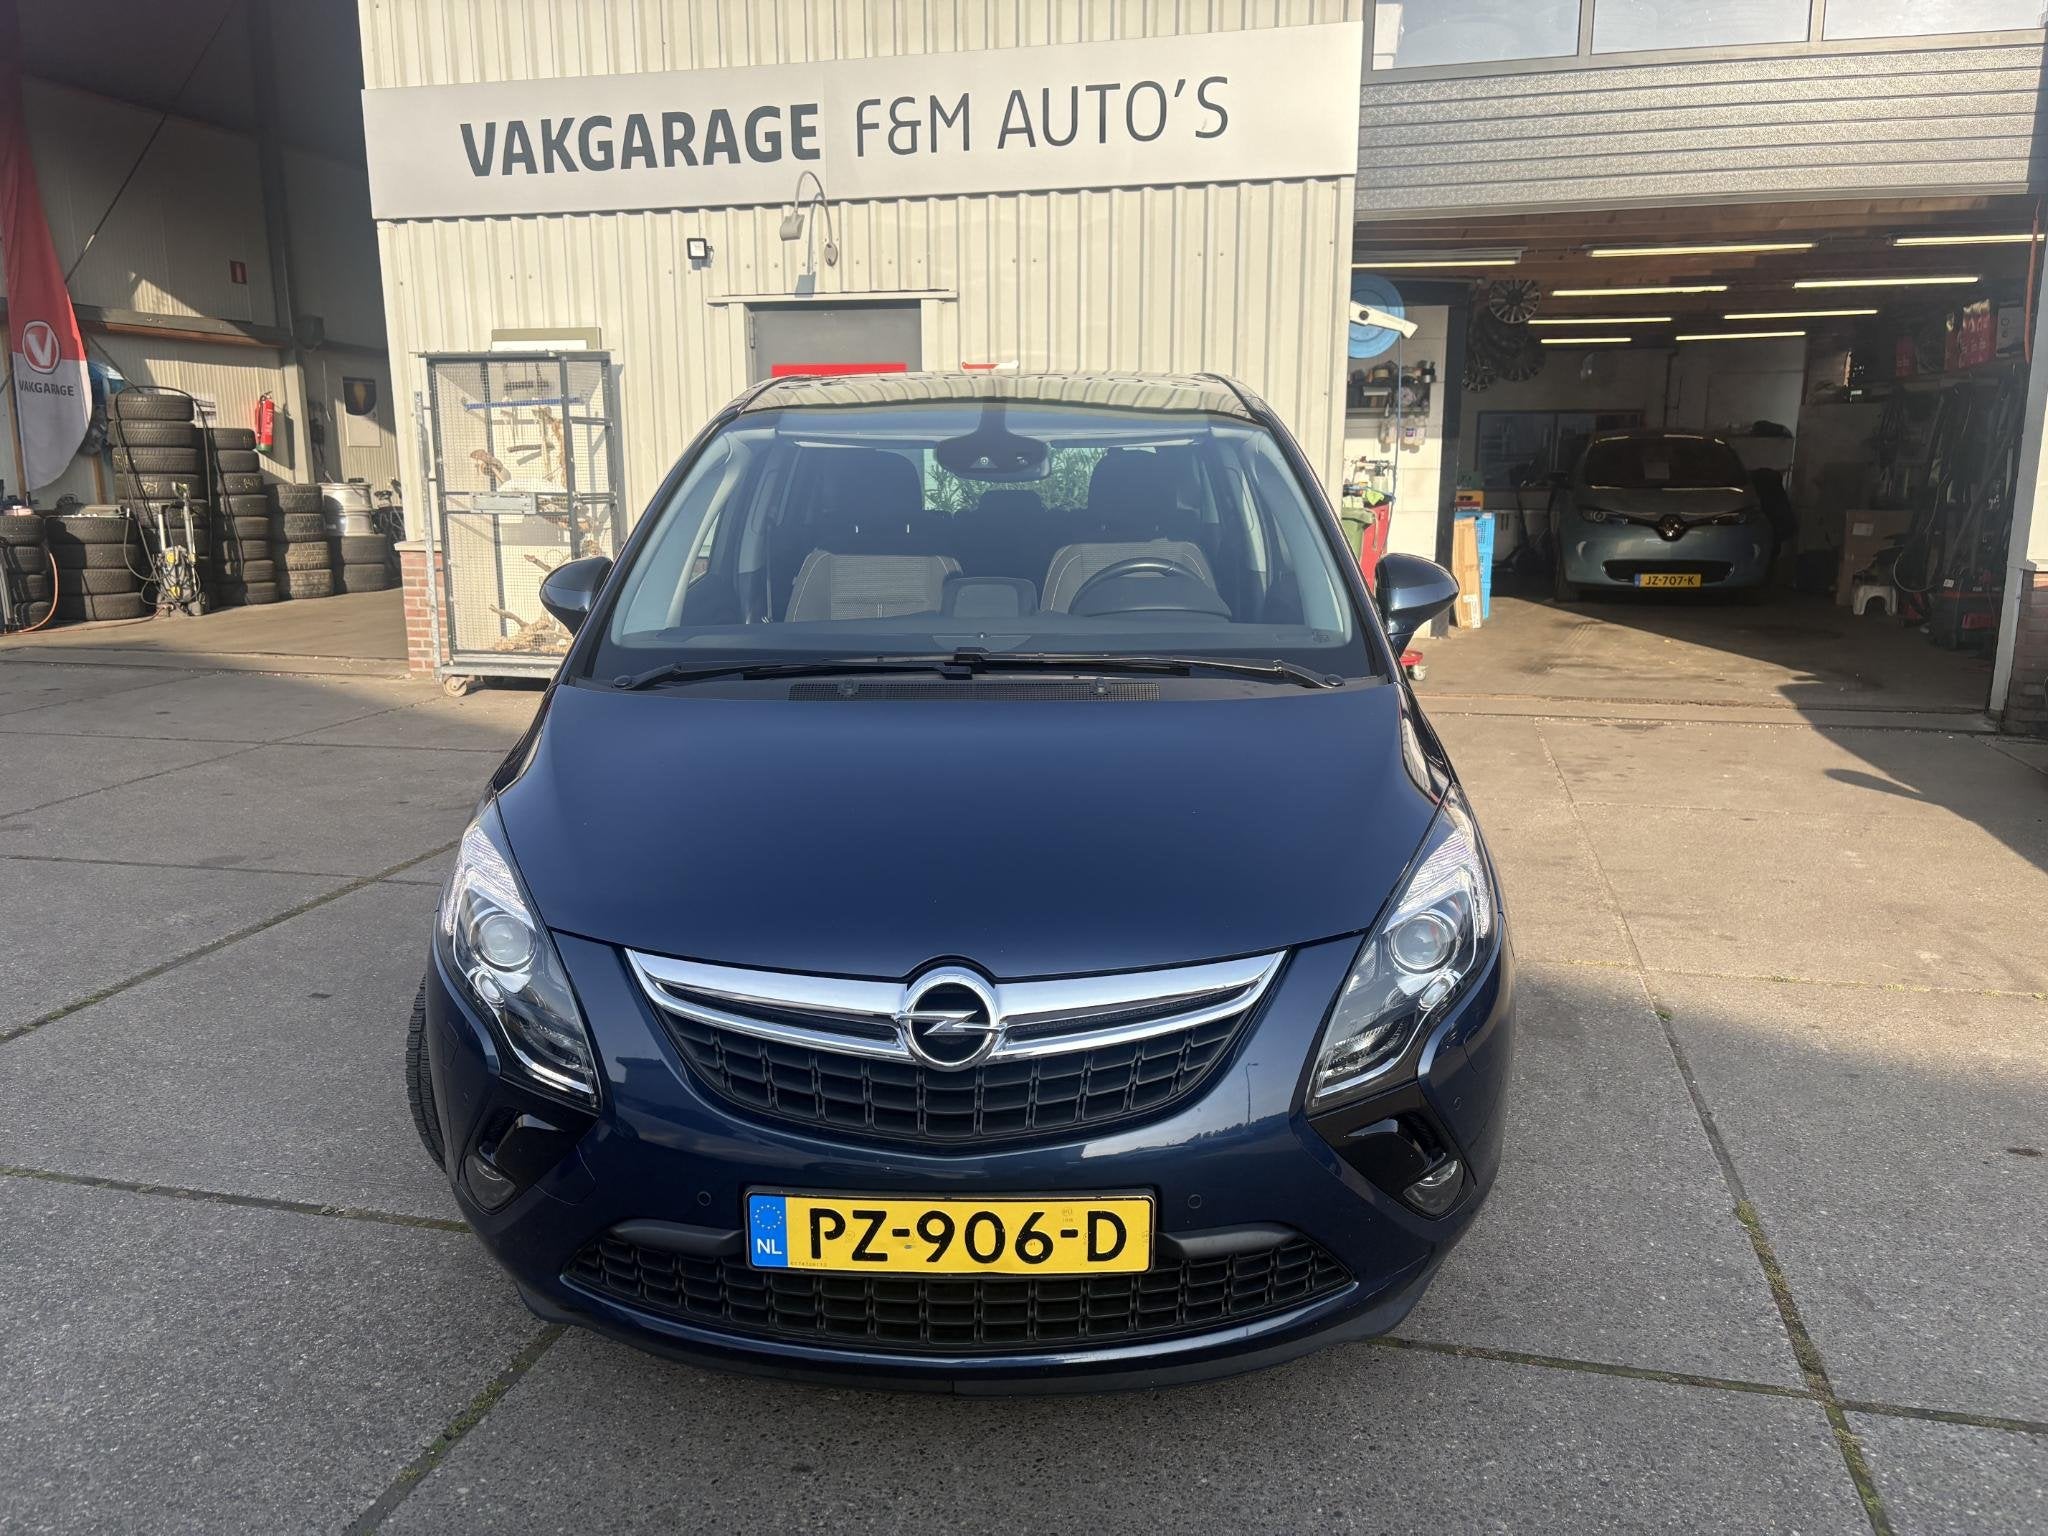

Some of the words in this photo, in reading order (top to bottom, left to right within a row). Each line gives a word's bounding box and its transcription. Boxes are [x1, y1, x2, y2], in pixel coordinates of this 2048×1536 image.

[460, 103, 821, 177] VAKGARAGE
[856, 93, 970, 157] F&M
[997, 76, 1229, 149] AUTO'S
[19, 380, 75, 396] VAKGARAGE
[1645, 575, 1695, 586] JZ-707-K
[808, 1207, 1128, 1265] PZ-906-D
[757, 1238, 783, 1255] NL
